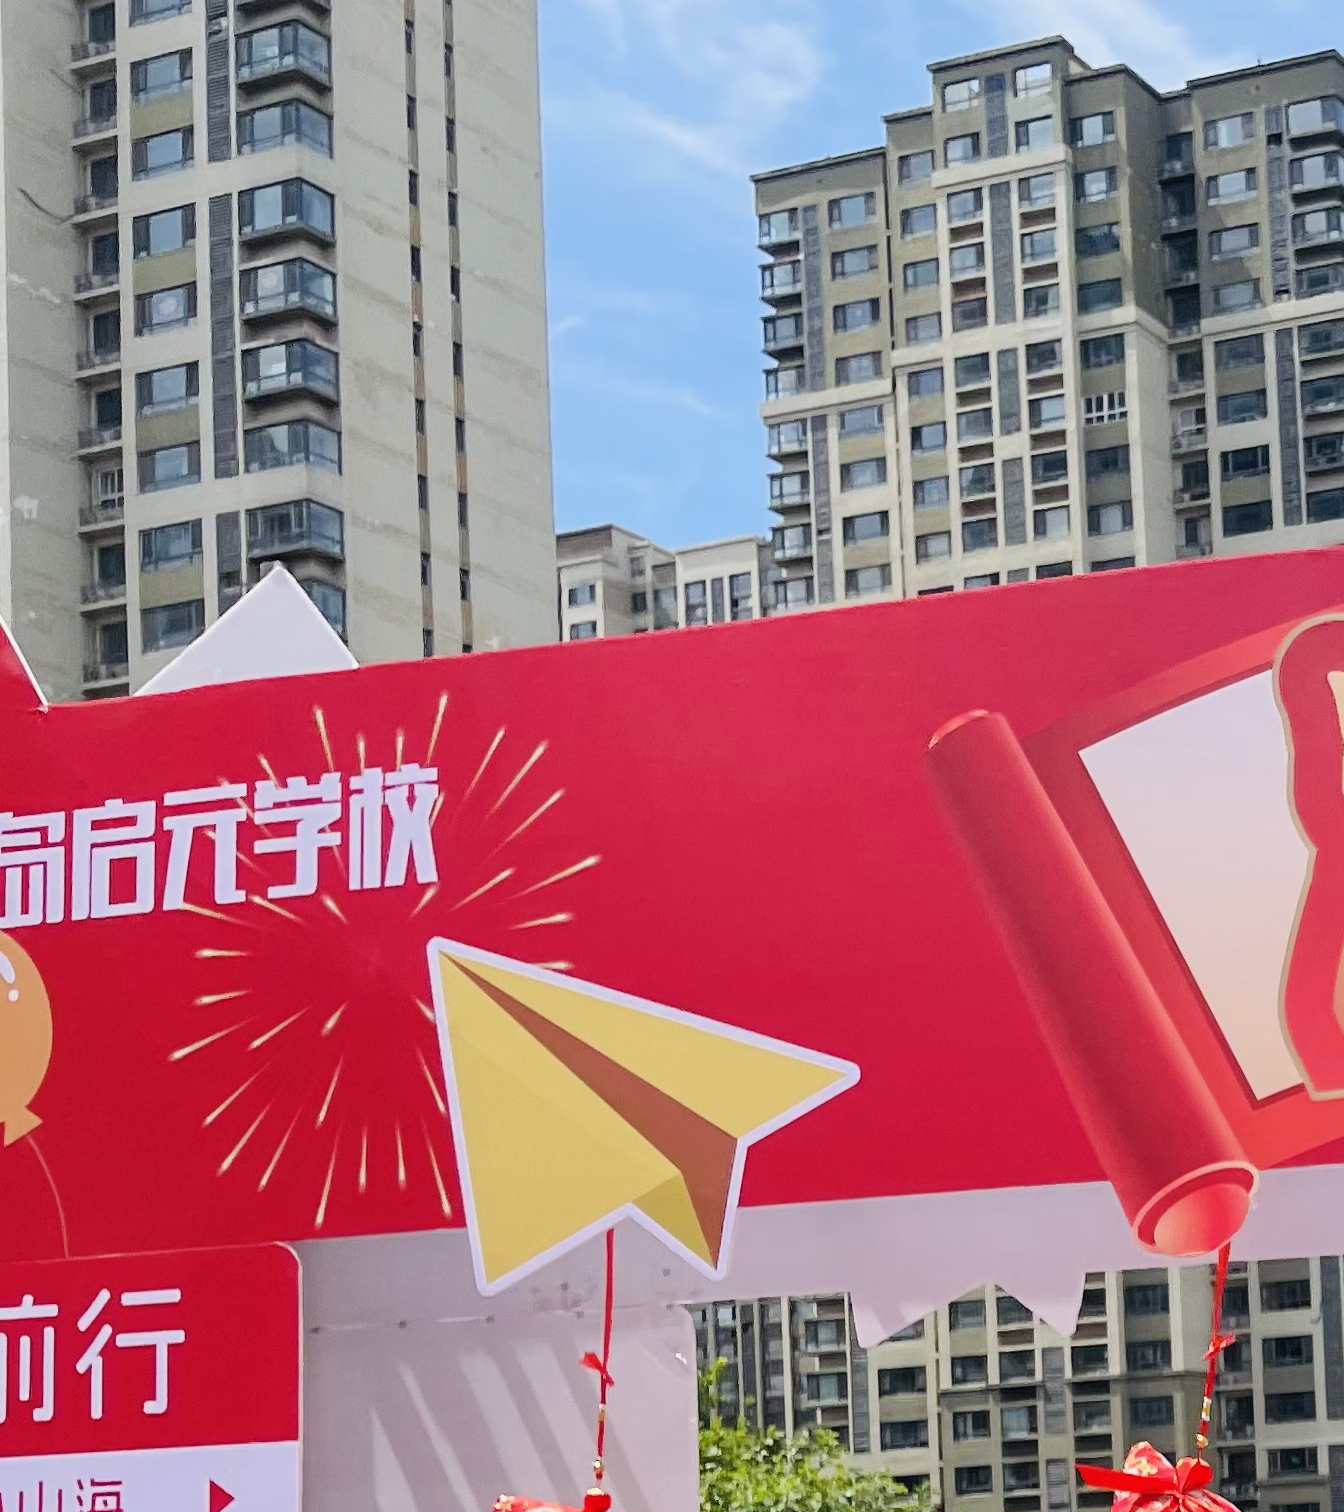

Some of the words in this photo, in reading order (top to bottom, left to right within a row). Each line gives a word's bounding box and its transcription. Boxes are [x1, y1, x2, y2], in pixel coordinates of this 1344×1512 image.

[0, 763, 440, 929] 岛启元学校
